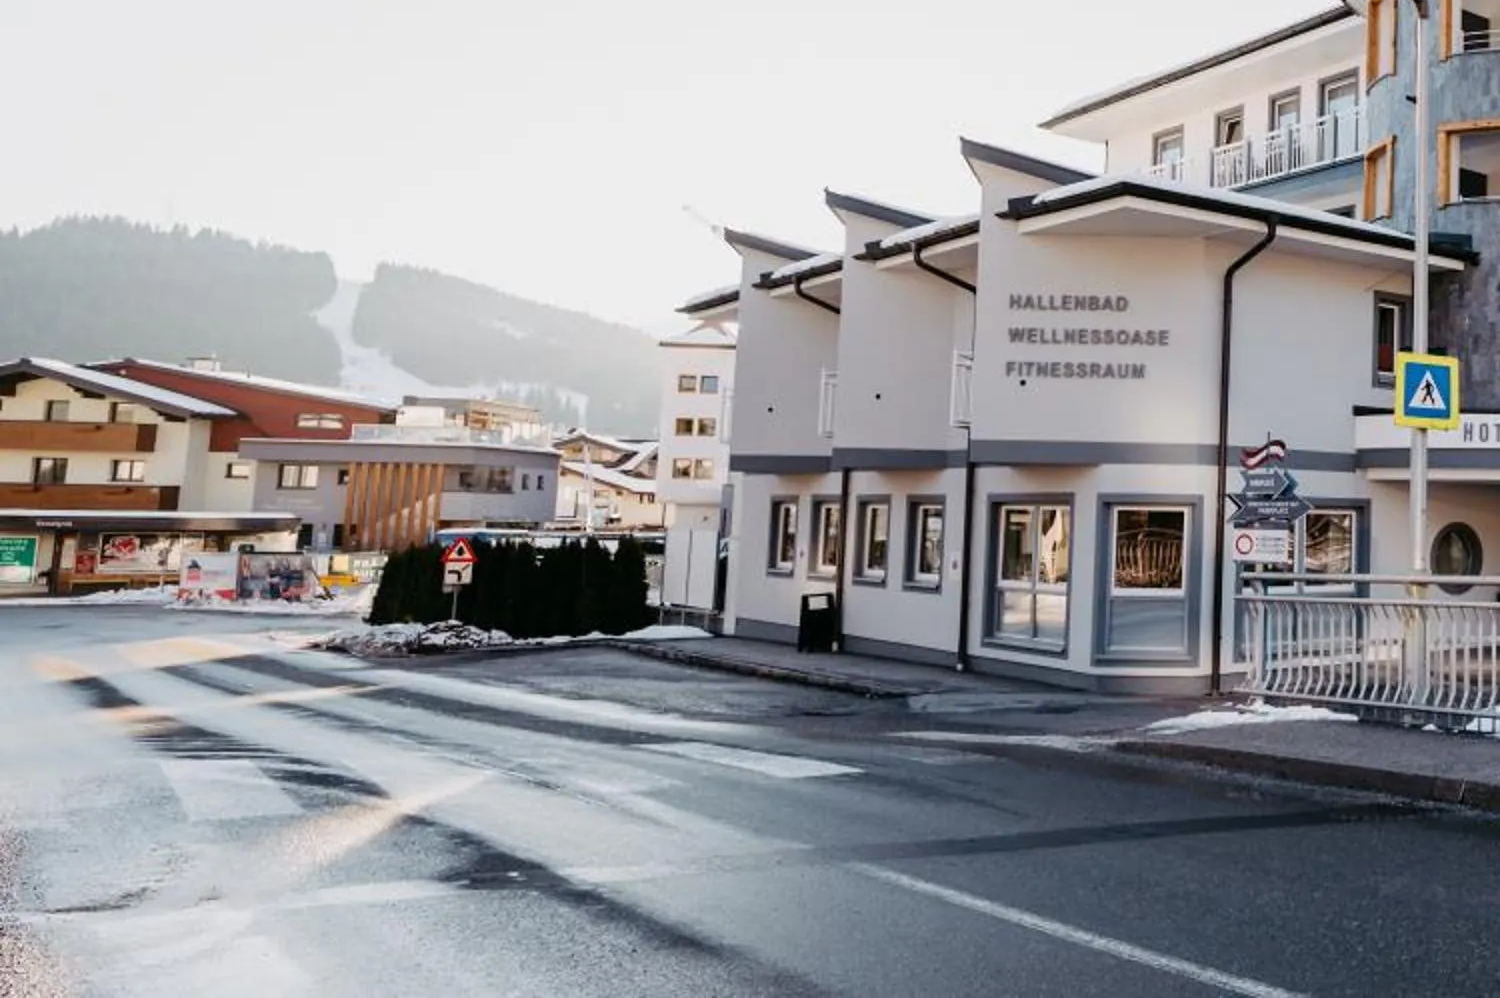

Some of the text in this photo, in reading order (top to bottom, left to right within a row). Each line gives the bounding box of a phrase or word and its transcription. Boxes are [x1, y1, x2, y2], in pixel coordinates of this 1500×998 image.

[1009, 293, 1130, 312] HALLENBAD
[1007, 327, 1170, 347] WELLNESSOASE
[1005, 360, 1147, 380] FITNESSRAUM
